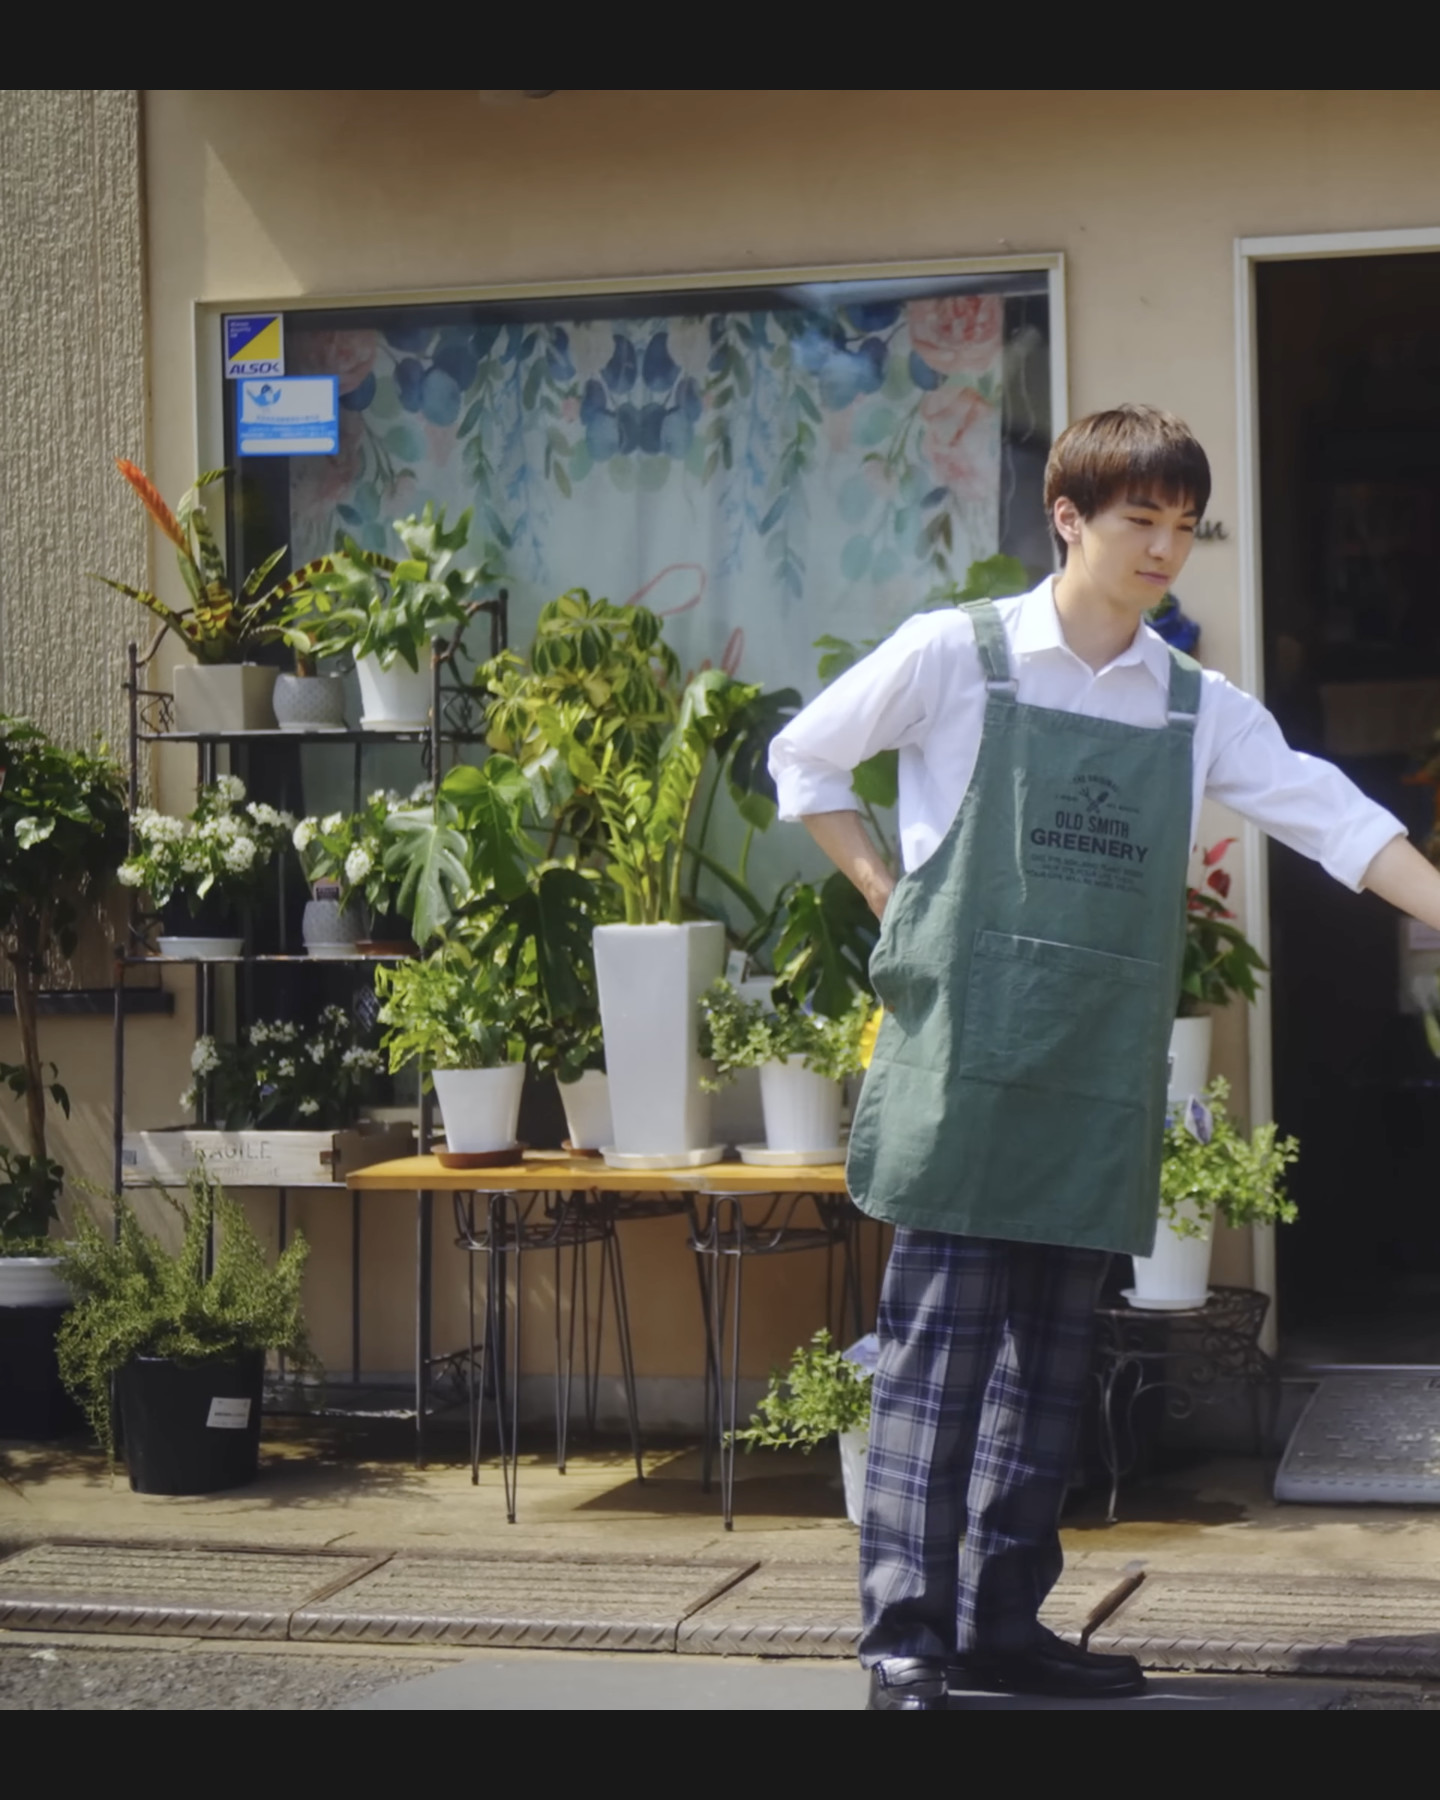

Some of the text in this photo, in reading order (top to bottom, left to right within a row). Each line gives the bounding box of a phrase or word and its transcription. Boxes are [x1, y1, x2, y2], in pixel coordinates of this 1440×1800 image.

[229, 362, 280, 375] ALSOK
[1055, 810, 1130, 839] OLD SMITH
[1030, 827, 1149, 864] GREENERY
